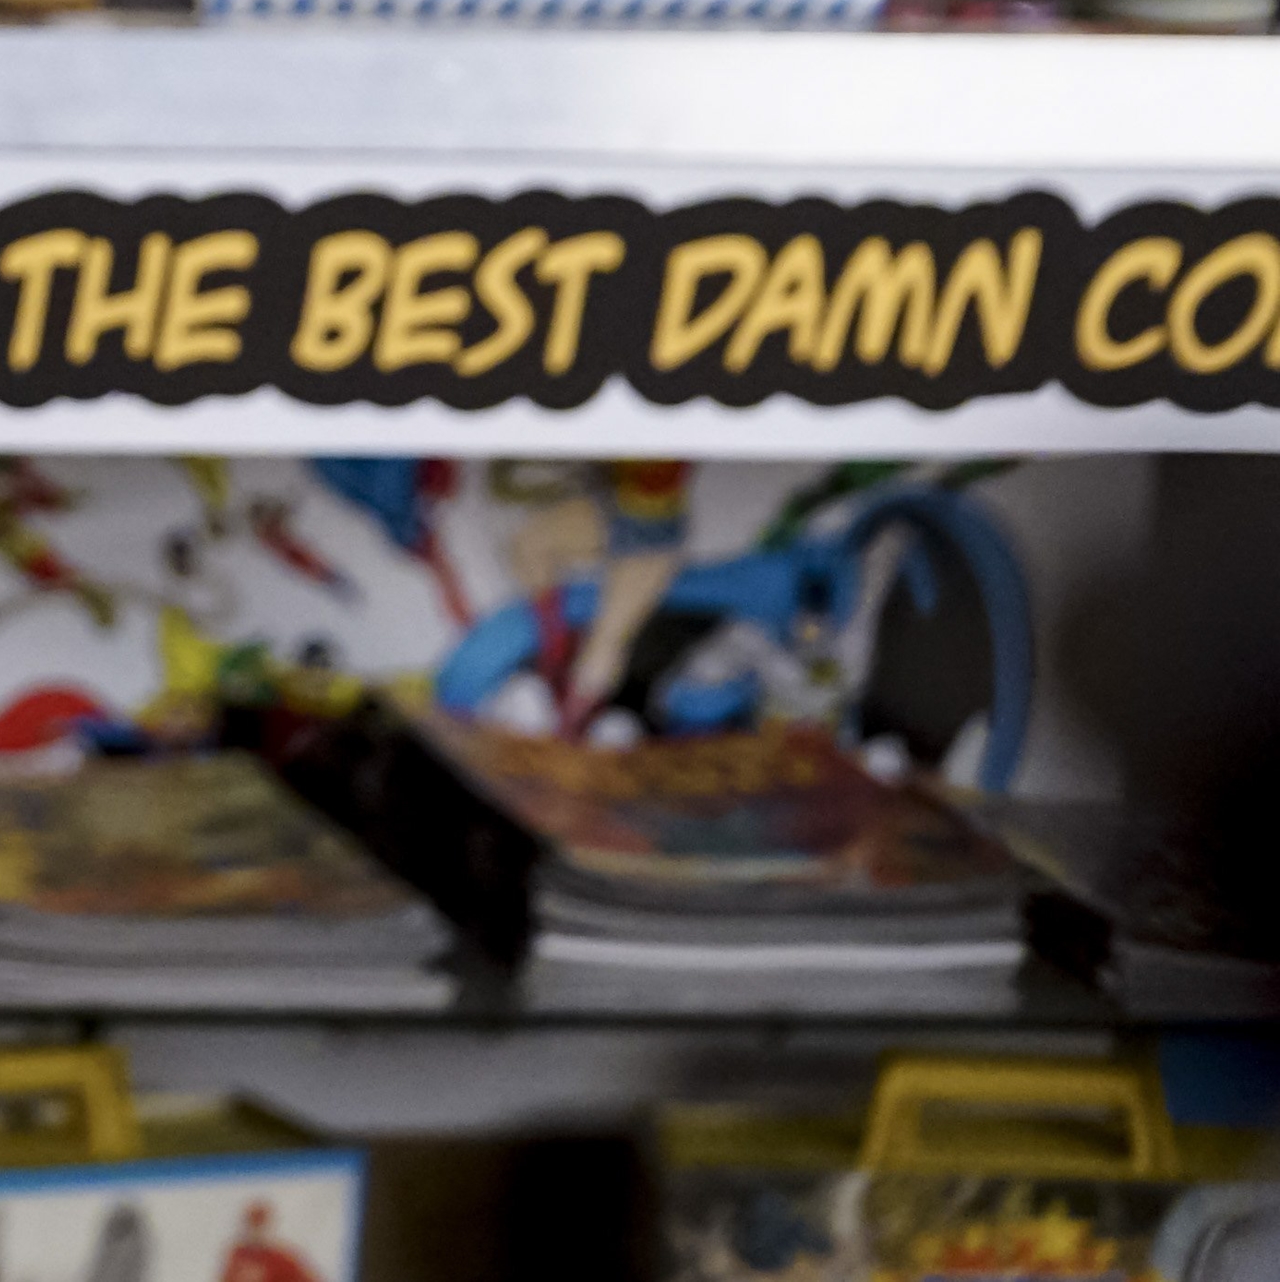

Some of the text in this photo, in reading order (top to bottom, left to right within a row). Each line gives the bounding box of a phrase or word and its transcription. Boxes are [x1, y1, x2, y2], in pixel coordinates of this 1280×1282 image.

[289, 226, 627, 378] BEST
[648, 227, 1044, 377] DAMN
[1074, 231, 1280, 375] CO
